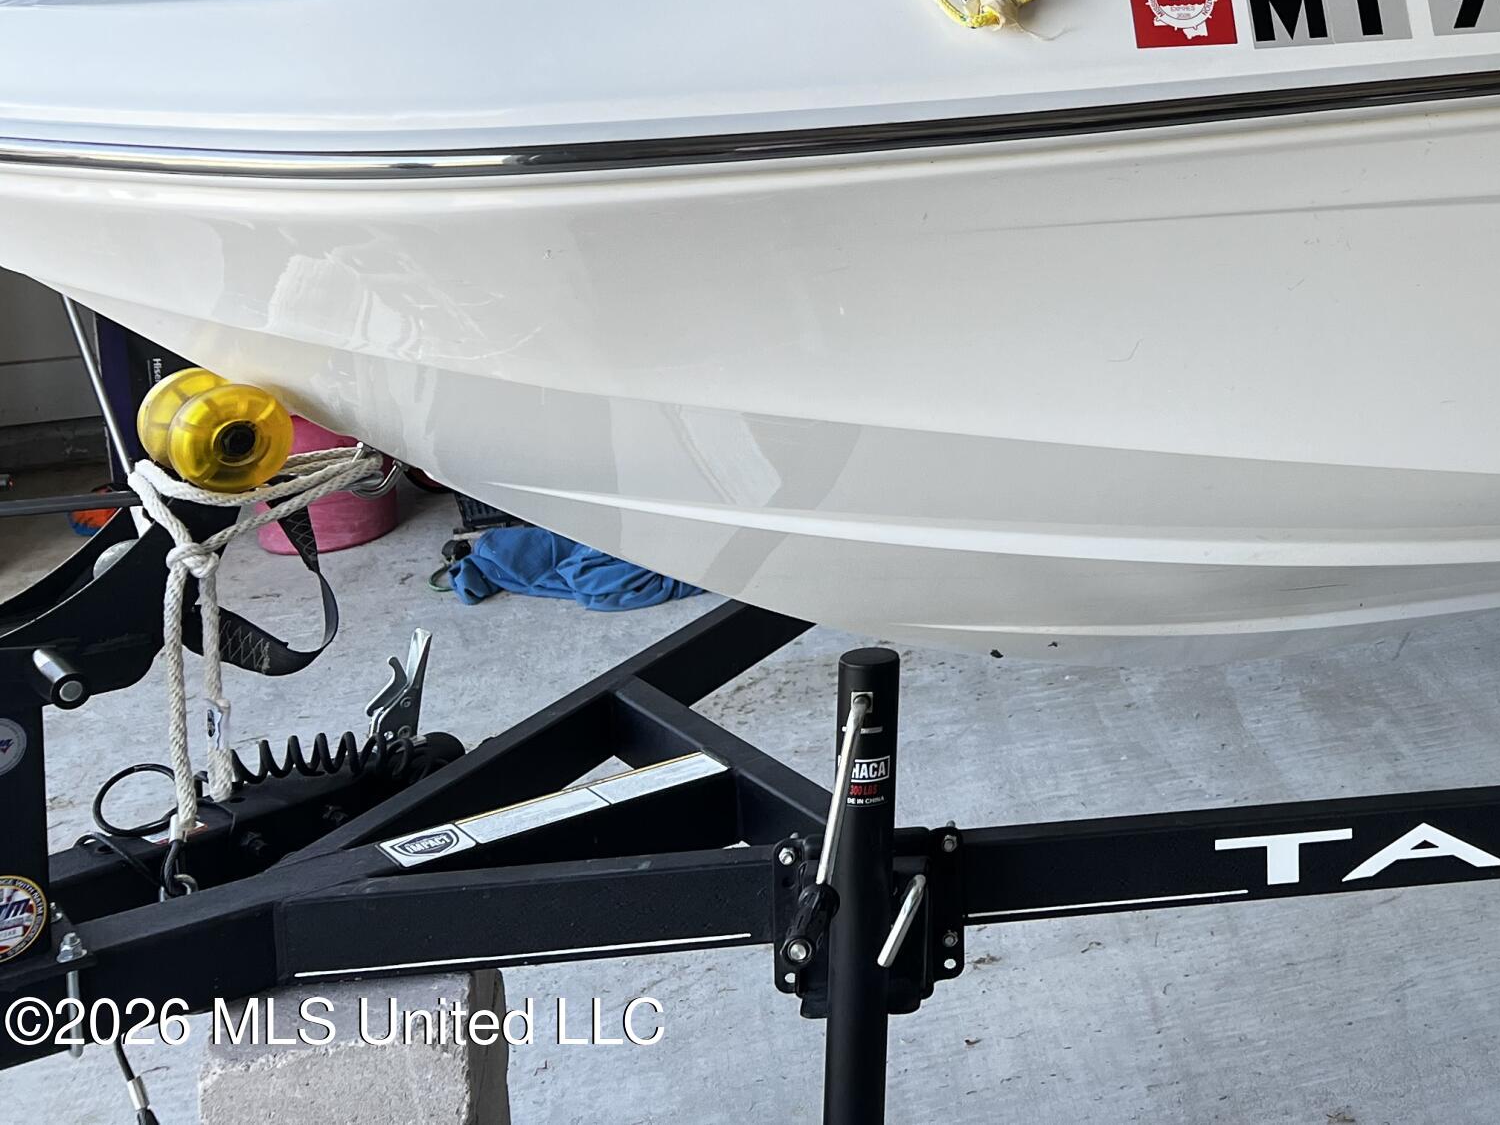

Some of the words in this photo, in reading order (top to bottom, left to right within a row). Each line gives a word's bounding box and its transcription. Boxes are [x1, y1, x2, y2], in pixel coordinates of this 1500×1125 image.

[153, 357, 162, 383] Hise
[851, 760, 886, 779] HACA
[404, 834, 451, 854] IMPACT
